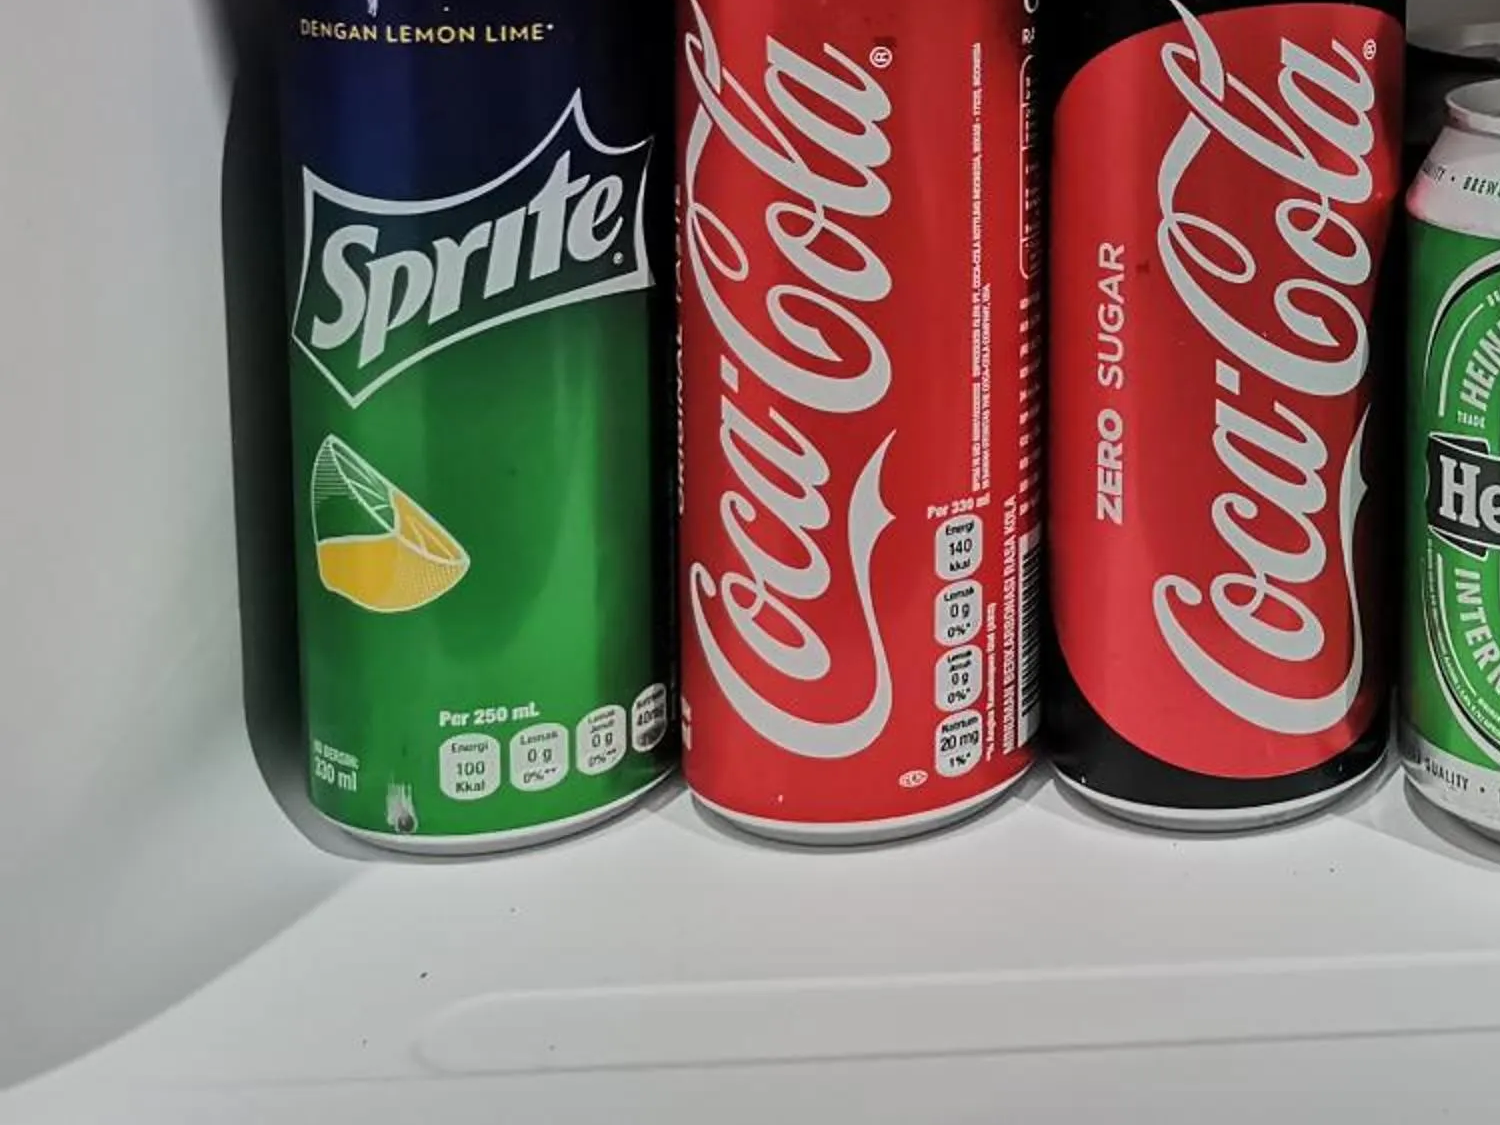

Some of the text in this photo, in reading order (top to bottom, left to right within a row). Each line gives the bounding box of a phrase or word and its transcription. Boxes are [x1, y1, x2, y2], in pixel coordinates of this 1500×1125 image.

[300, 18, 377, 41] DENGAN
[386, 25, 476, 44] LEMON
[311, 149, 624, 369] Sprite
[1096, 242, 1126, 525] ZERO SUGAR
[1004, 495, 1016, 534] KOLA
[945, 521, 974, 535] Energi
[949, 539, 973, 555] 140
[1004, 535, 1016, 575] RASA
[950, 604, 959, 618] 0
[440, 710, 470, 727] Per
[473, 706, 508, 725] 250
[940, 730, 979, 752] 20 mg
[456, 761, 485, 776] 100
